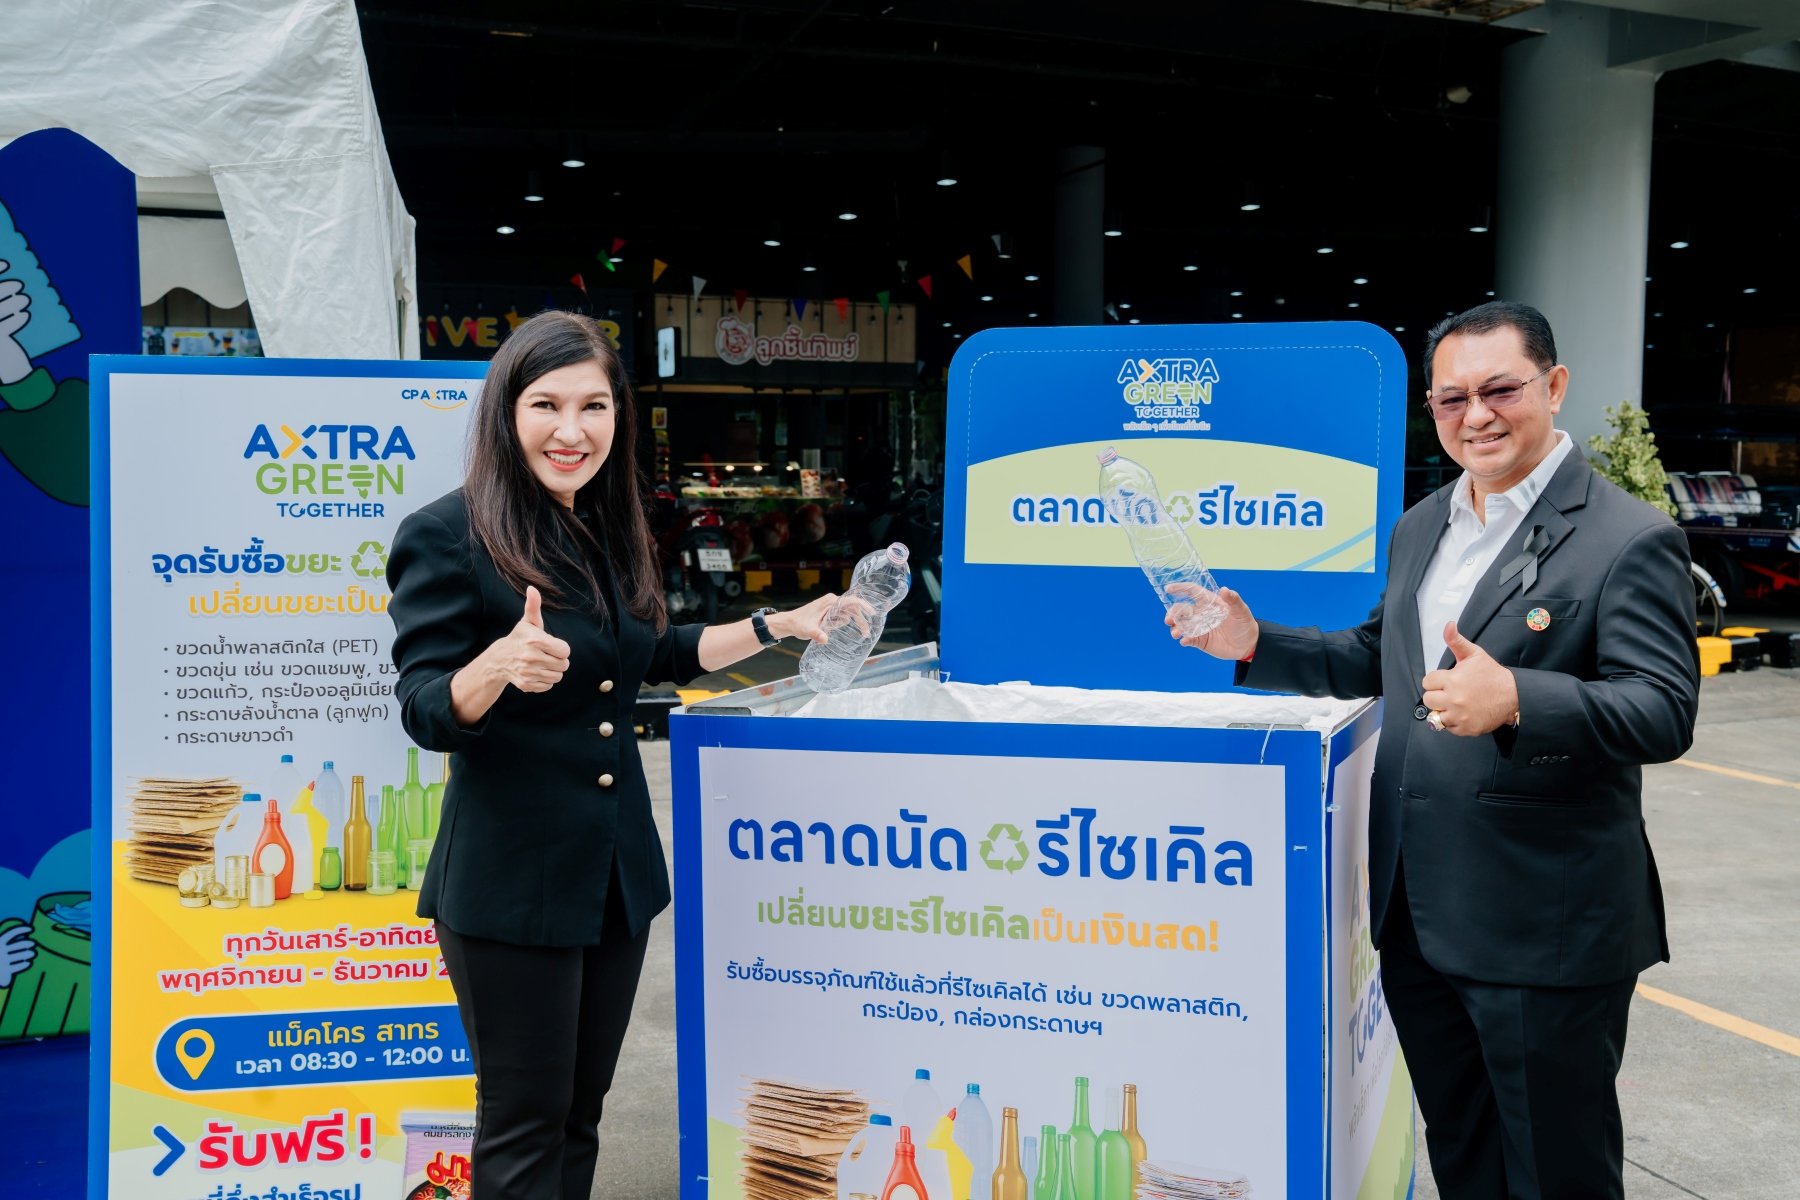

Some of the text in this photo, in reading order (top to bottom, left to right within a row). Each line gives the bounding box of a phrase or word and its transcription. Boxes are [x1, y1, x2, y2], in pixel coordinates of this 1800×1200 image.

[757, 327, 857, 363] ลูกชิ้นทิพย์
[1118, 358, 1219, 383] AXTRA
[401, 389, 419, 401] CP
[1123, 382, 1212, 405] GREEN
[1135, 406, 1199, 418] TOGETHER
[243, 423, 416, 461] AXTRA
[255, 462, 404, 498] GREEN
[276, 502, 385, 518] TOGETHER
[1198, 484, 1324, 527] รีไซเคิล
[151, 537, 342, 583] จุดรับซื้อขยะ
[176, 635, 378, 656] ขวดน้ำพลาสติกใส (PET)
[176, 661, 237, 681] ขวดขุ่น
[244, 661, 273, 676] เช่น
[281, 663, 371, 679] ขวดแชมพู,
[176, 681, 396, 701] ขวดแก้ว, กระป๋องอลูมิเนีย
[177, 700, 389, 723] กระดาษลังน้ำตาล (ลูกฟูก)
[177, 726, 294, 744] กระดาษขาวดำ
[728, 807, 1254, 887] ตลาดนัด รีไซเคิล
[757, 887, 1220, 953] เปลี่ยนขยะรีไซเคิลเป็นเงินสด!
[161, 965, 301, 993] พฤศจิกายน
[334, 959, 428, 982] ธันวาคม
[726, 956, 1249, 1022] รับซื้อบรรจุภัณฑ์ใช้แล้วที่รีไซเคิลได้ เช่น ขวดพลาสติก,
[862, 999, 1103, 1036] กระป๋อง, กล่องกระดาษฯ
[268, 1021, 439, 1048] แม็คโคร สาทร
[235, 1055, 282, 1075] เวลา
[290, 1049, 358, 1072] 08:30
[383, 1044, 443, 1067] 12:00
[451, 1047, 470, 1065] น.
[198, 1113, 372, 1170] รับฟรี !
